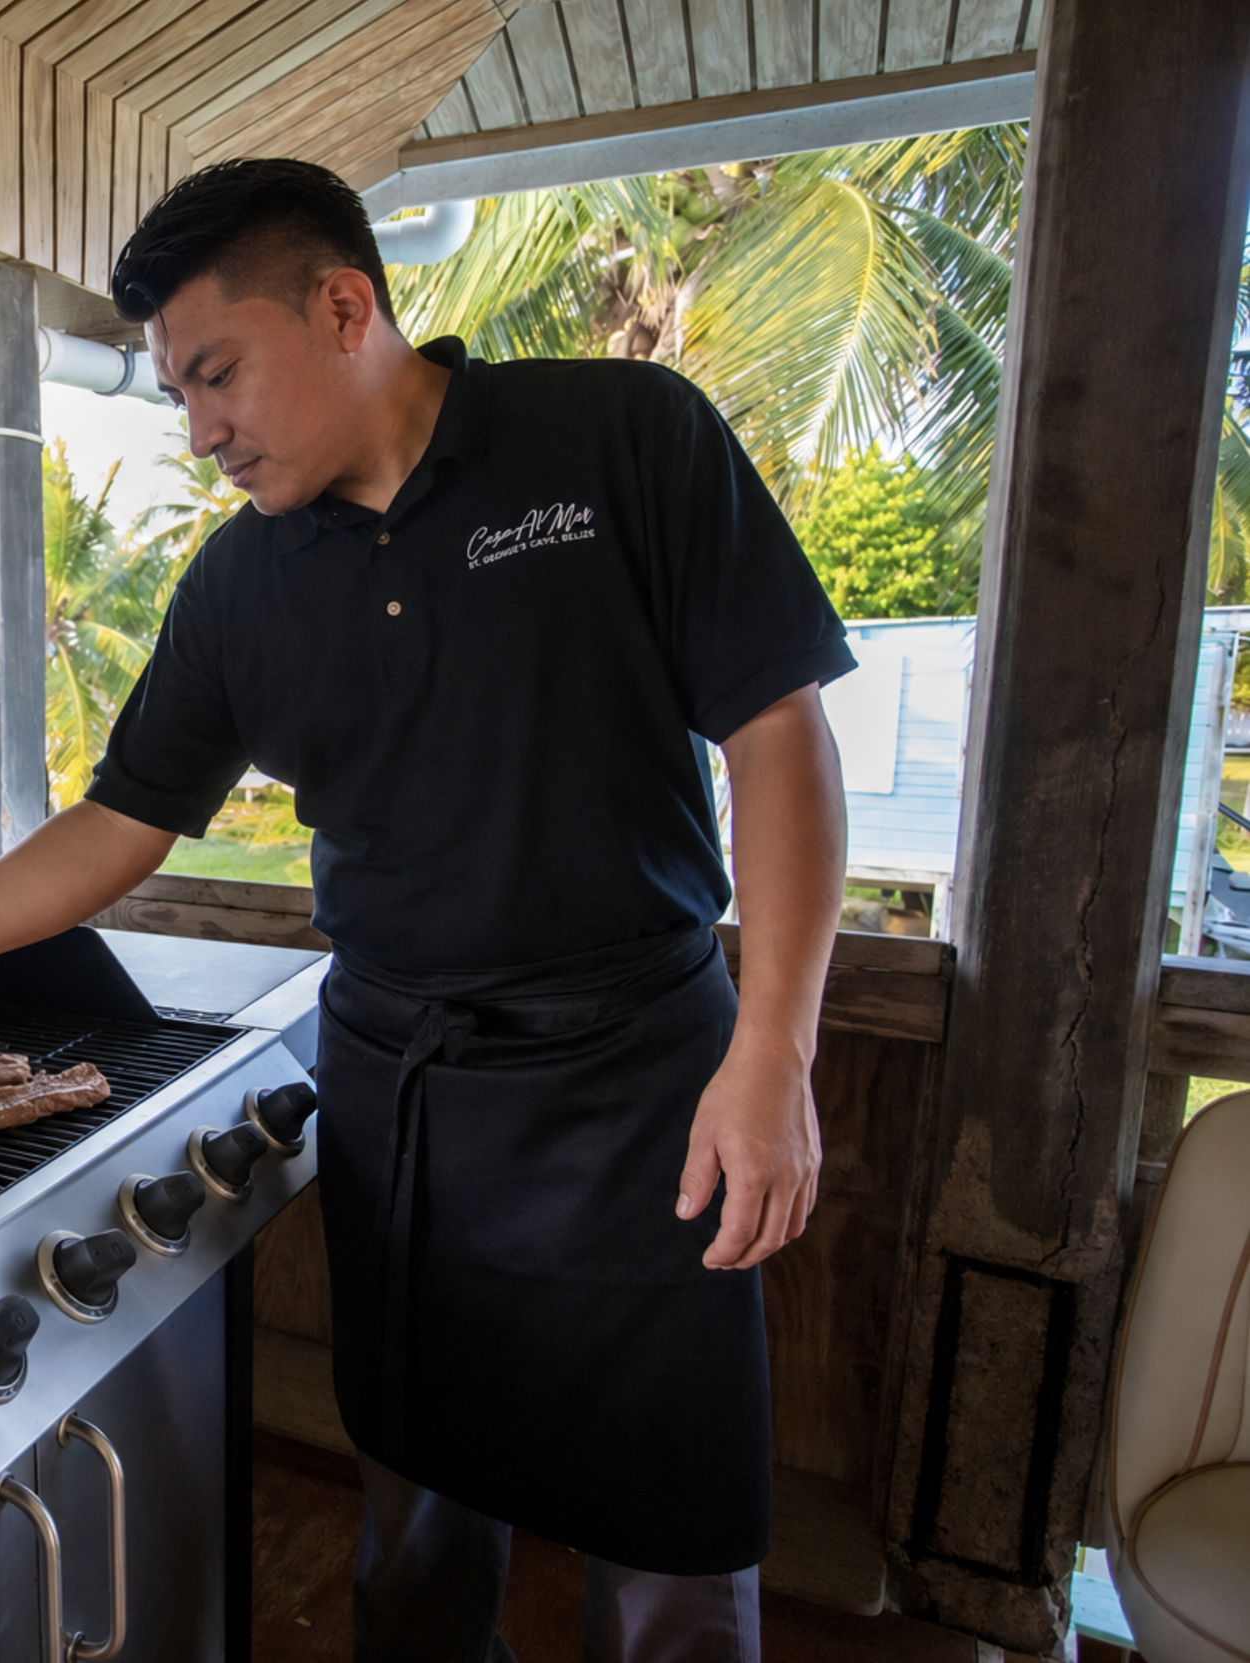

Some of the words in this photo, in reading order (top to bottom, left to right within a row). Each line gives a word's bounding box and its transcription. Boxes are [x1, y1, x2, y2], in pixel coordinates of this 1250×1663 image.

[467, 526, 514, 560] Casa
[541, 503, 594, 536] Mar
[561, 528, 596, 543] BELIZE
